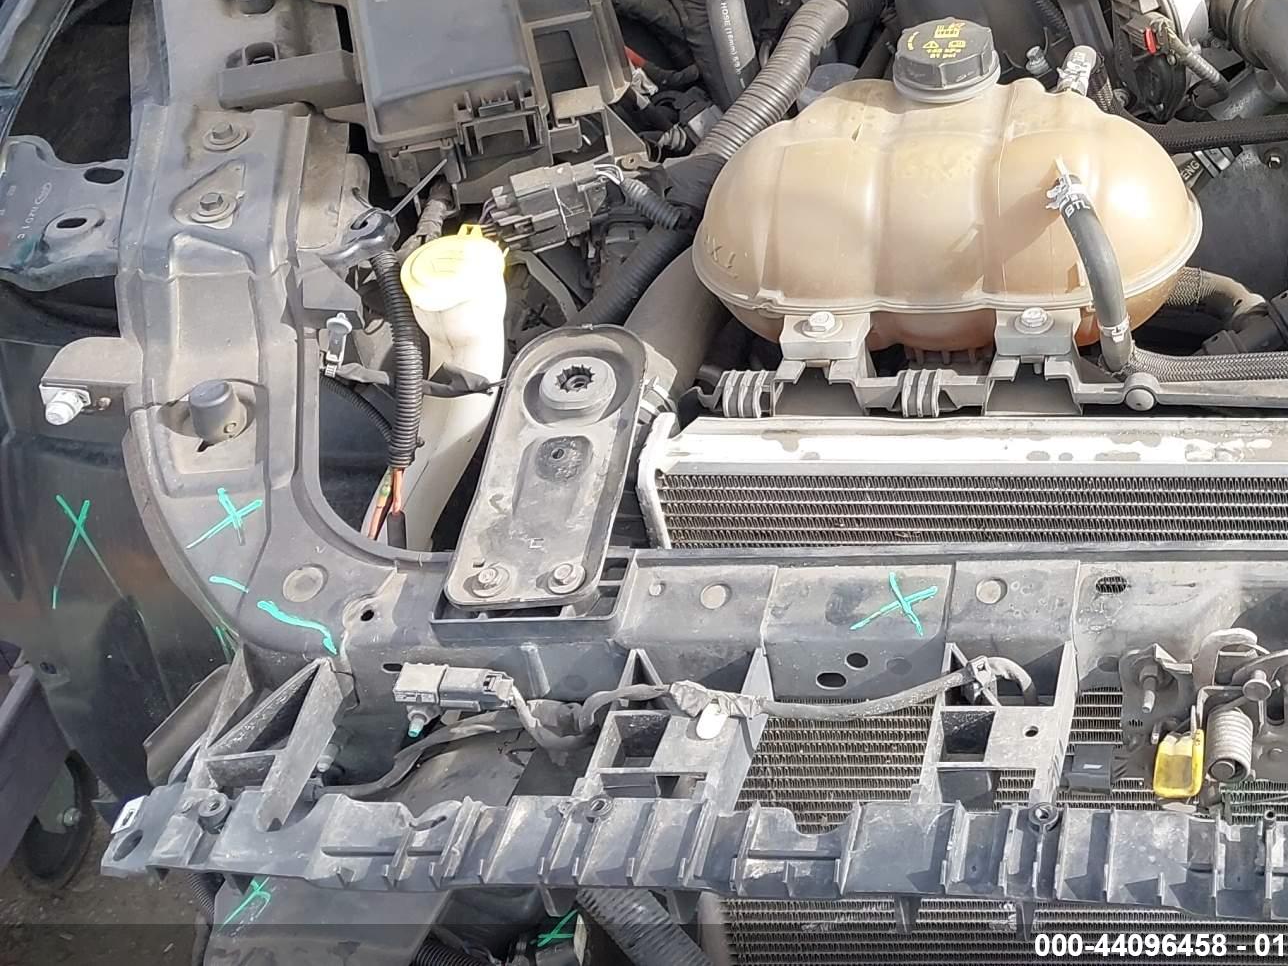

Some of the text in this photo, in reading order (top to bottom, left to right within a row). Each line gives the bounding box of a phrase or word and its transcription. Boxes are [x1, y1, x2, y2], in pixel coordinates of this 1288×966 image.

[720, 1, 732, 27] HOSE
[1180, 160, 1201, 181] ENG
[1064, 199, 1091, 219] BTL
